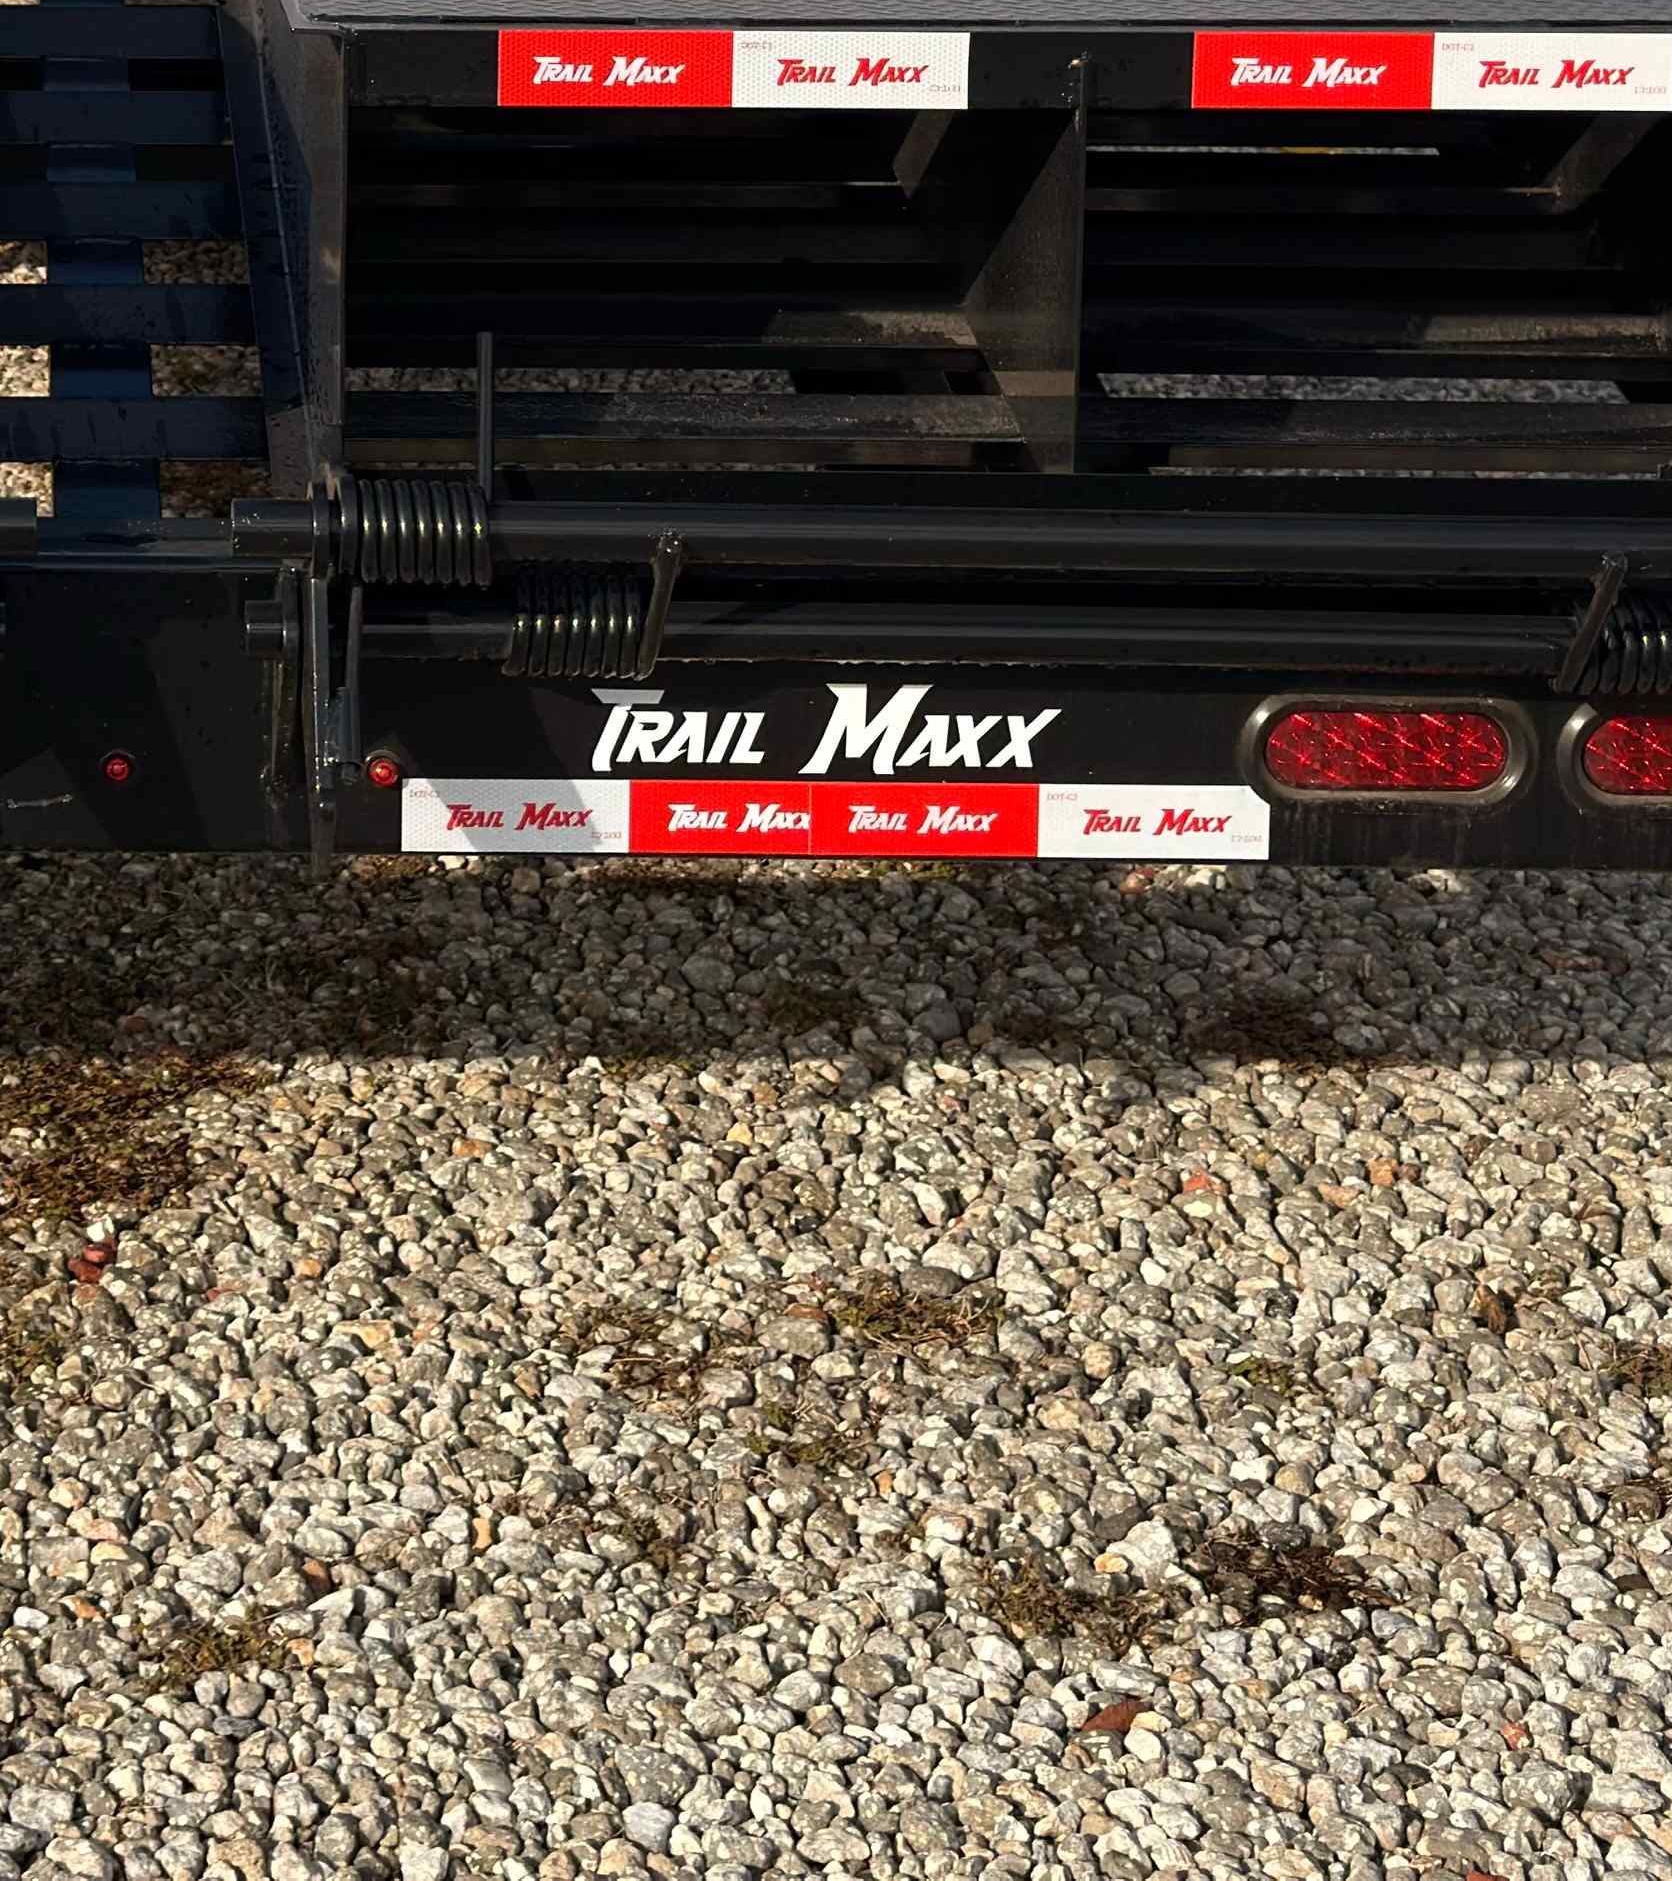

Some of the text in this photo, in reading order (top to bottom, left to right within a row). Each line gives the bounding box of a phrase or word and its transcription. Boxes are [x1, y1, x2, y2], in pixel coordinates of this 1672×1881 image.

[532, 56, 686, 87] TRAIL MAXX
[776, 57, 928, 87] TRAIL MAXX
[1230, 57, 1387, 88] TRAIL MAXX
[1478, 58, 1632, 89] TRAIL MAXX
[591, 683, 1063, 776] TRAIL MAXX
[446, 802, 591, 830] TRAIL MAXX
[667, 803, 728, 832] TRAIL
[848, 805, 998, 835] TRAIL MAXX
[1082, 808, 1229, 837] TRAIL MAXX
